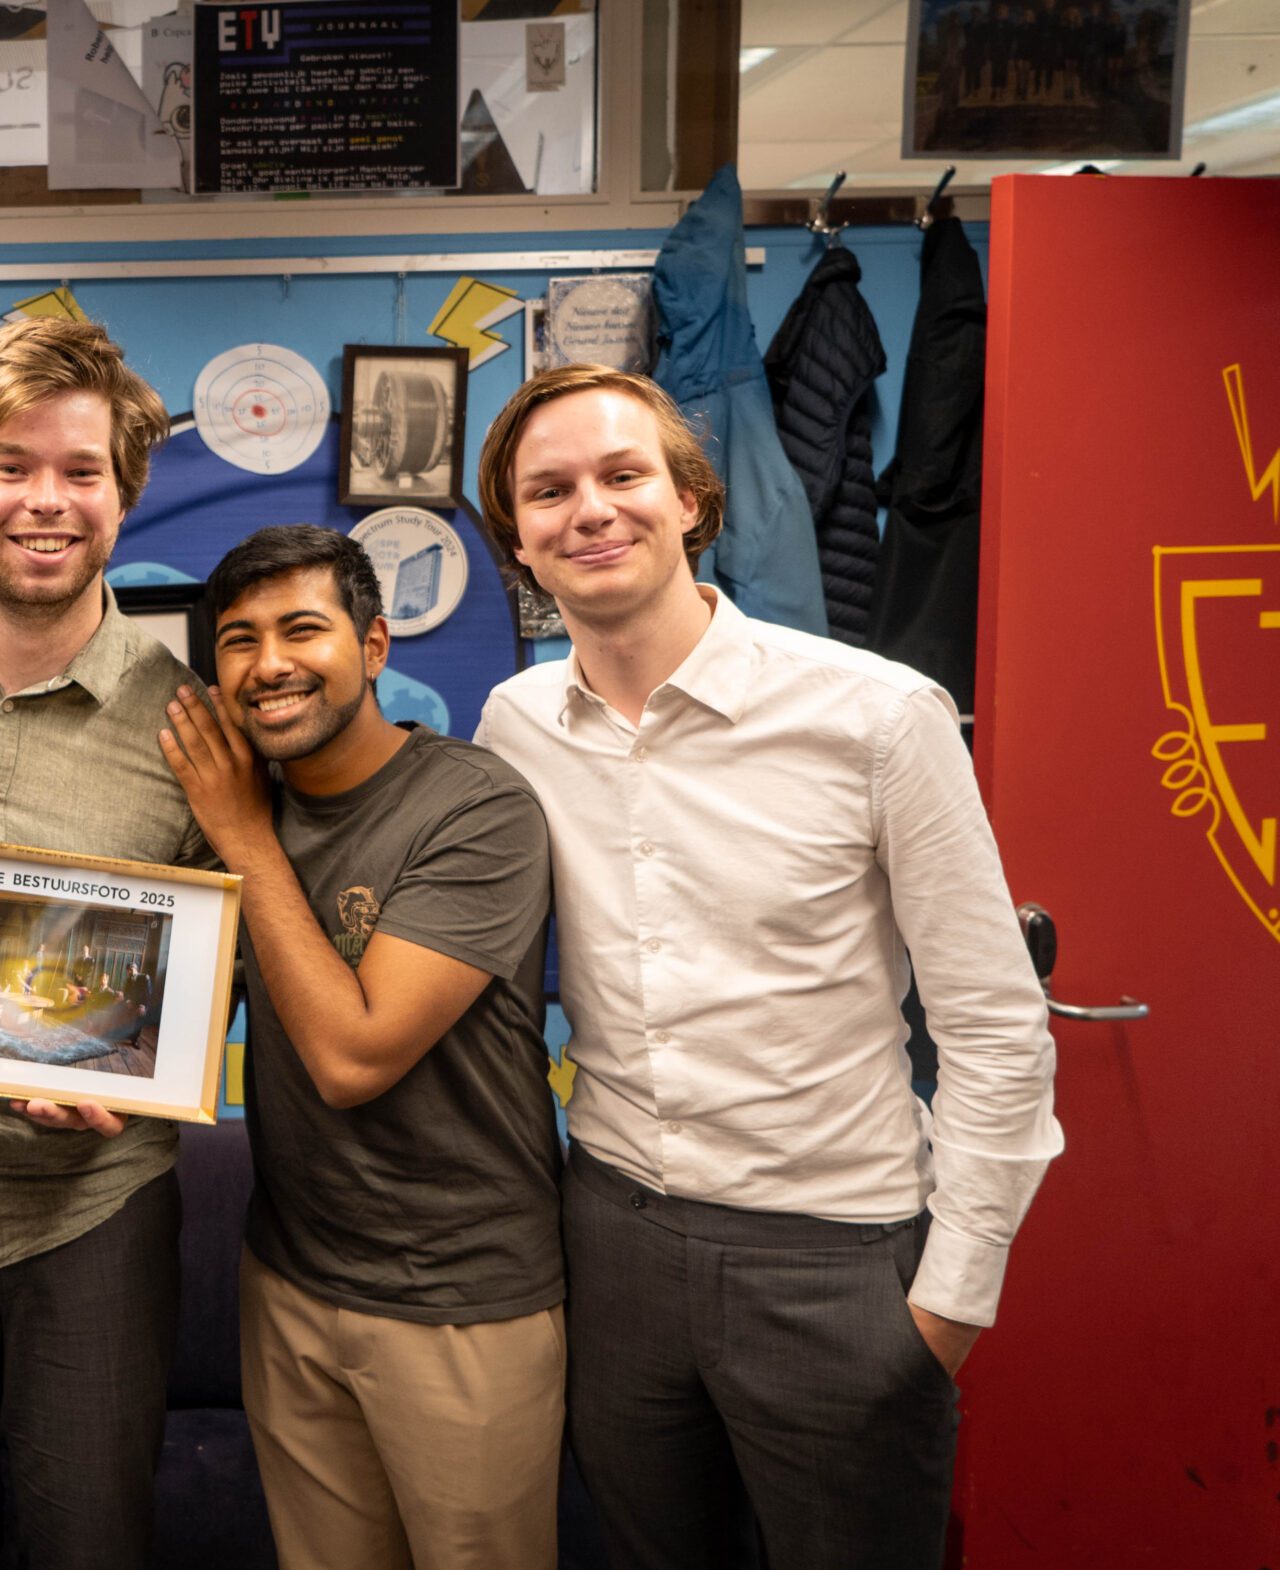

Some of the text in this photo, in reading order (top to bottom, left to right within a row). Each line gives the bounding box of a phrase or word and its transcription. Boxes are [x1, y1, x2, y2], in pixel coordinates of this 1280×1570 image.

[316, 20, 400, 32] JOURNAAL
[358, 514, 458, 558] pectrum Study Tour 2024
[13, 874, 130, 901] BESTUURSFOTO
[140, 891, 175, 908] 2025
